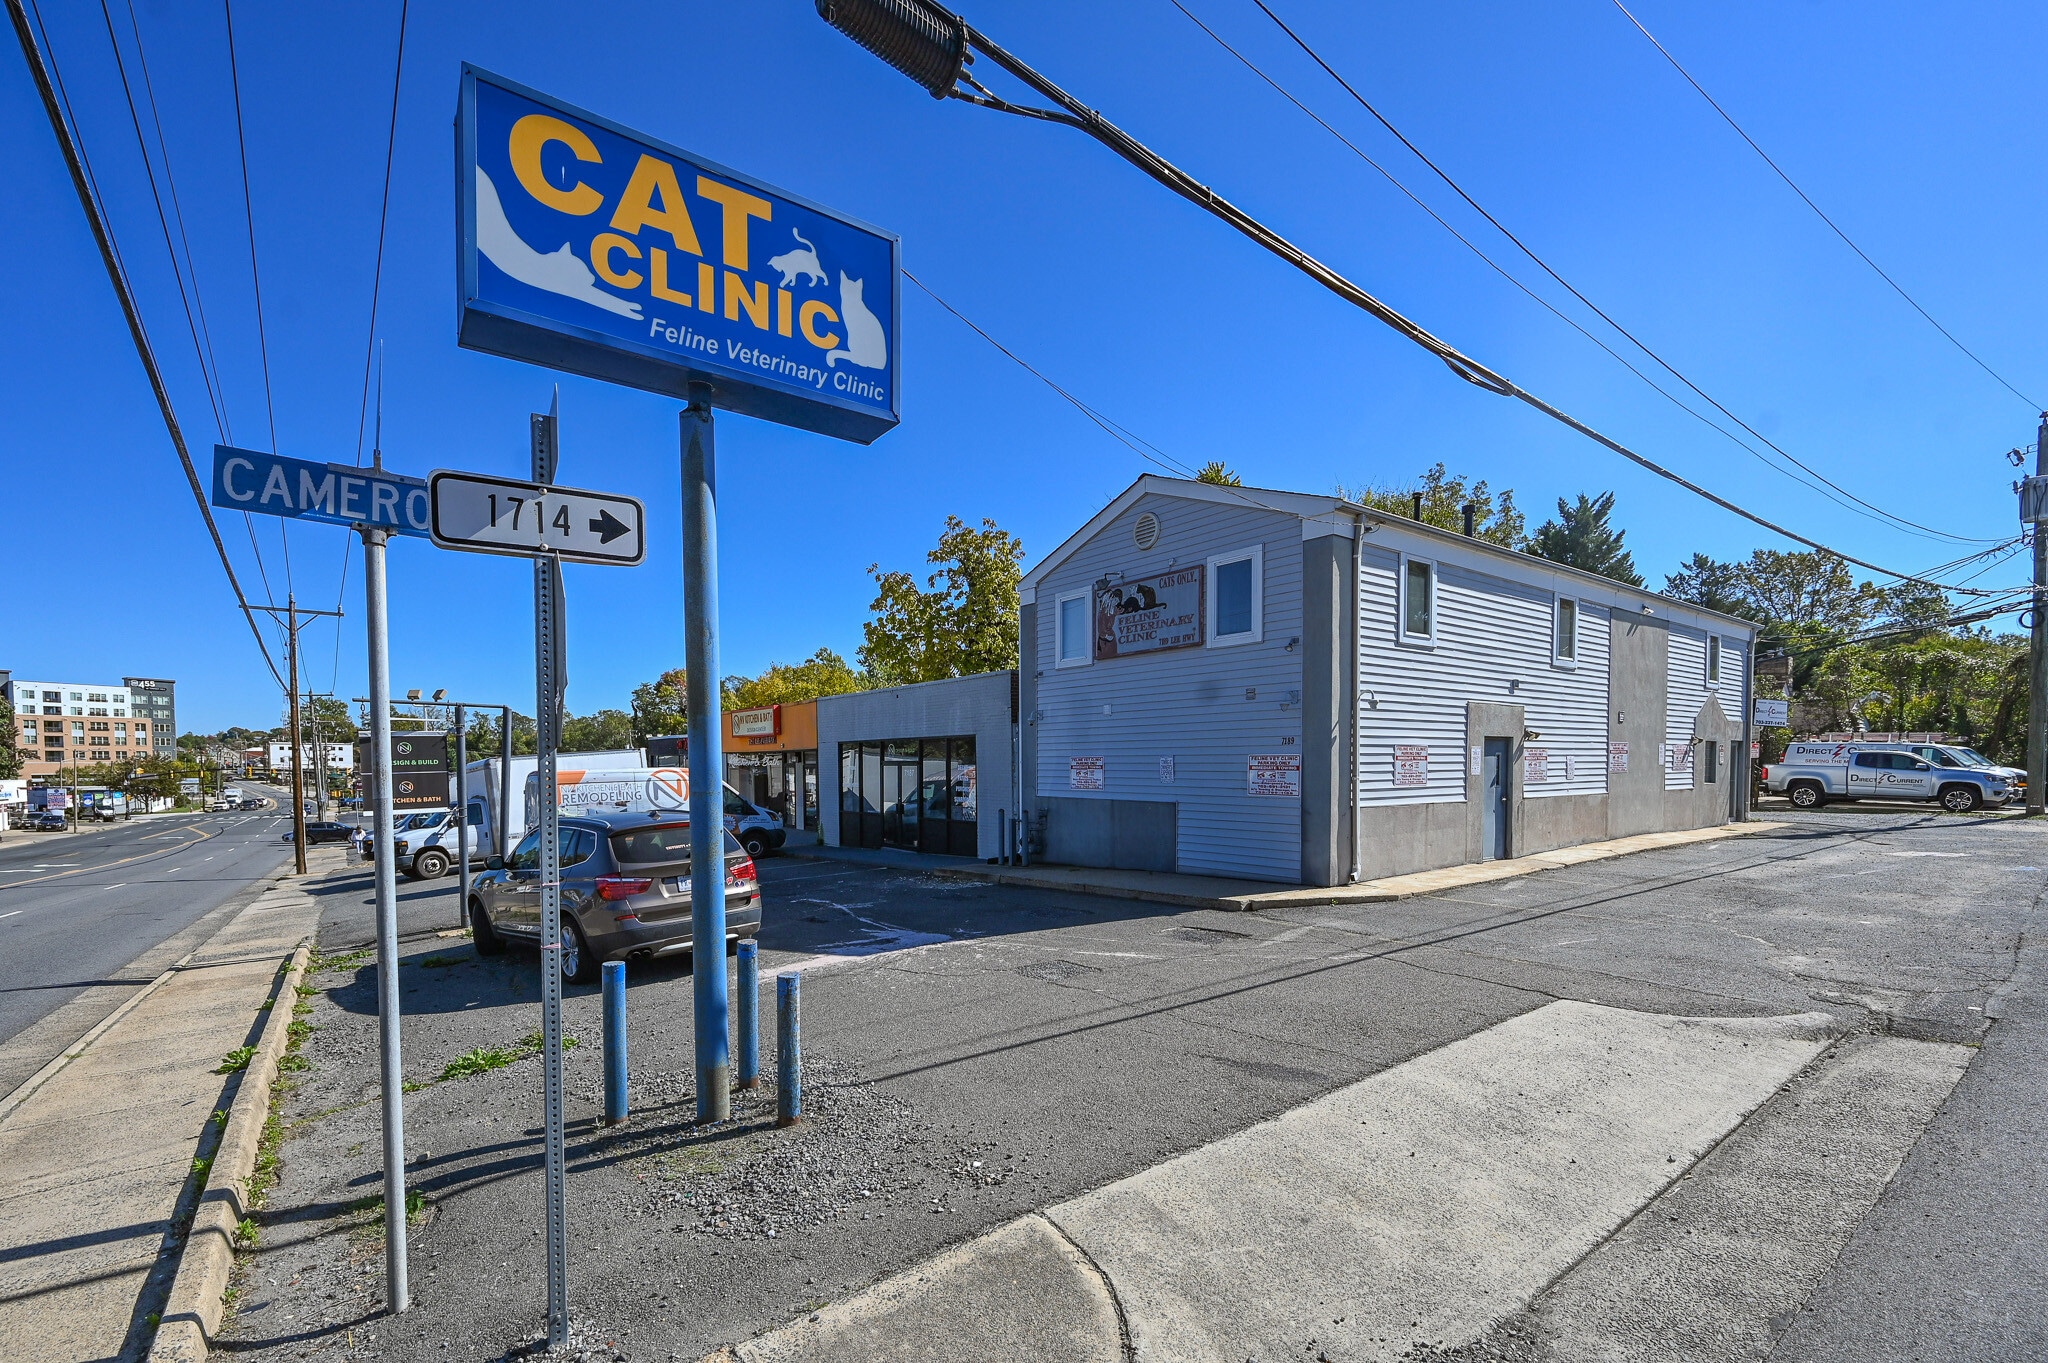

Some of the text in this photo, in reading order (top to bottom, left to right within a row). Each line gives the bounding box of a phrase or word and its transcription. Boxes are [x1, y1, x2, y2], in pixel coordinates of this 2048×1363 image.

[508, 113, 772, 272] CAT
[590, 232, 840, 350] CLINIC
[649, 317, 884, 401] Feline Veterinary Clinic
[487, 493, 571, 537] 1714
[1159, 574, 1176, 589] CATS
[1118, 610, 1160, 626] FELINE
[1118, 613, 1195, 635] VETERINARY
[1118, 630, 1158, 645] CLINIC
[1171, 635, 1181, 645] LEE
[762, 756, 780, 767] Bath
[577, 784, 612, 793] KITCHEN
[620, 782, 642, 792] BATH
[562, 791, 642, 804] REMODELING
